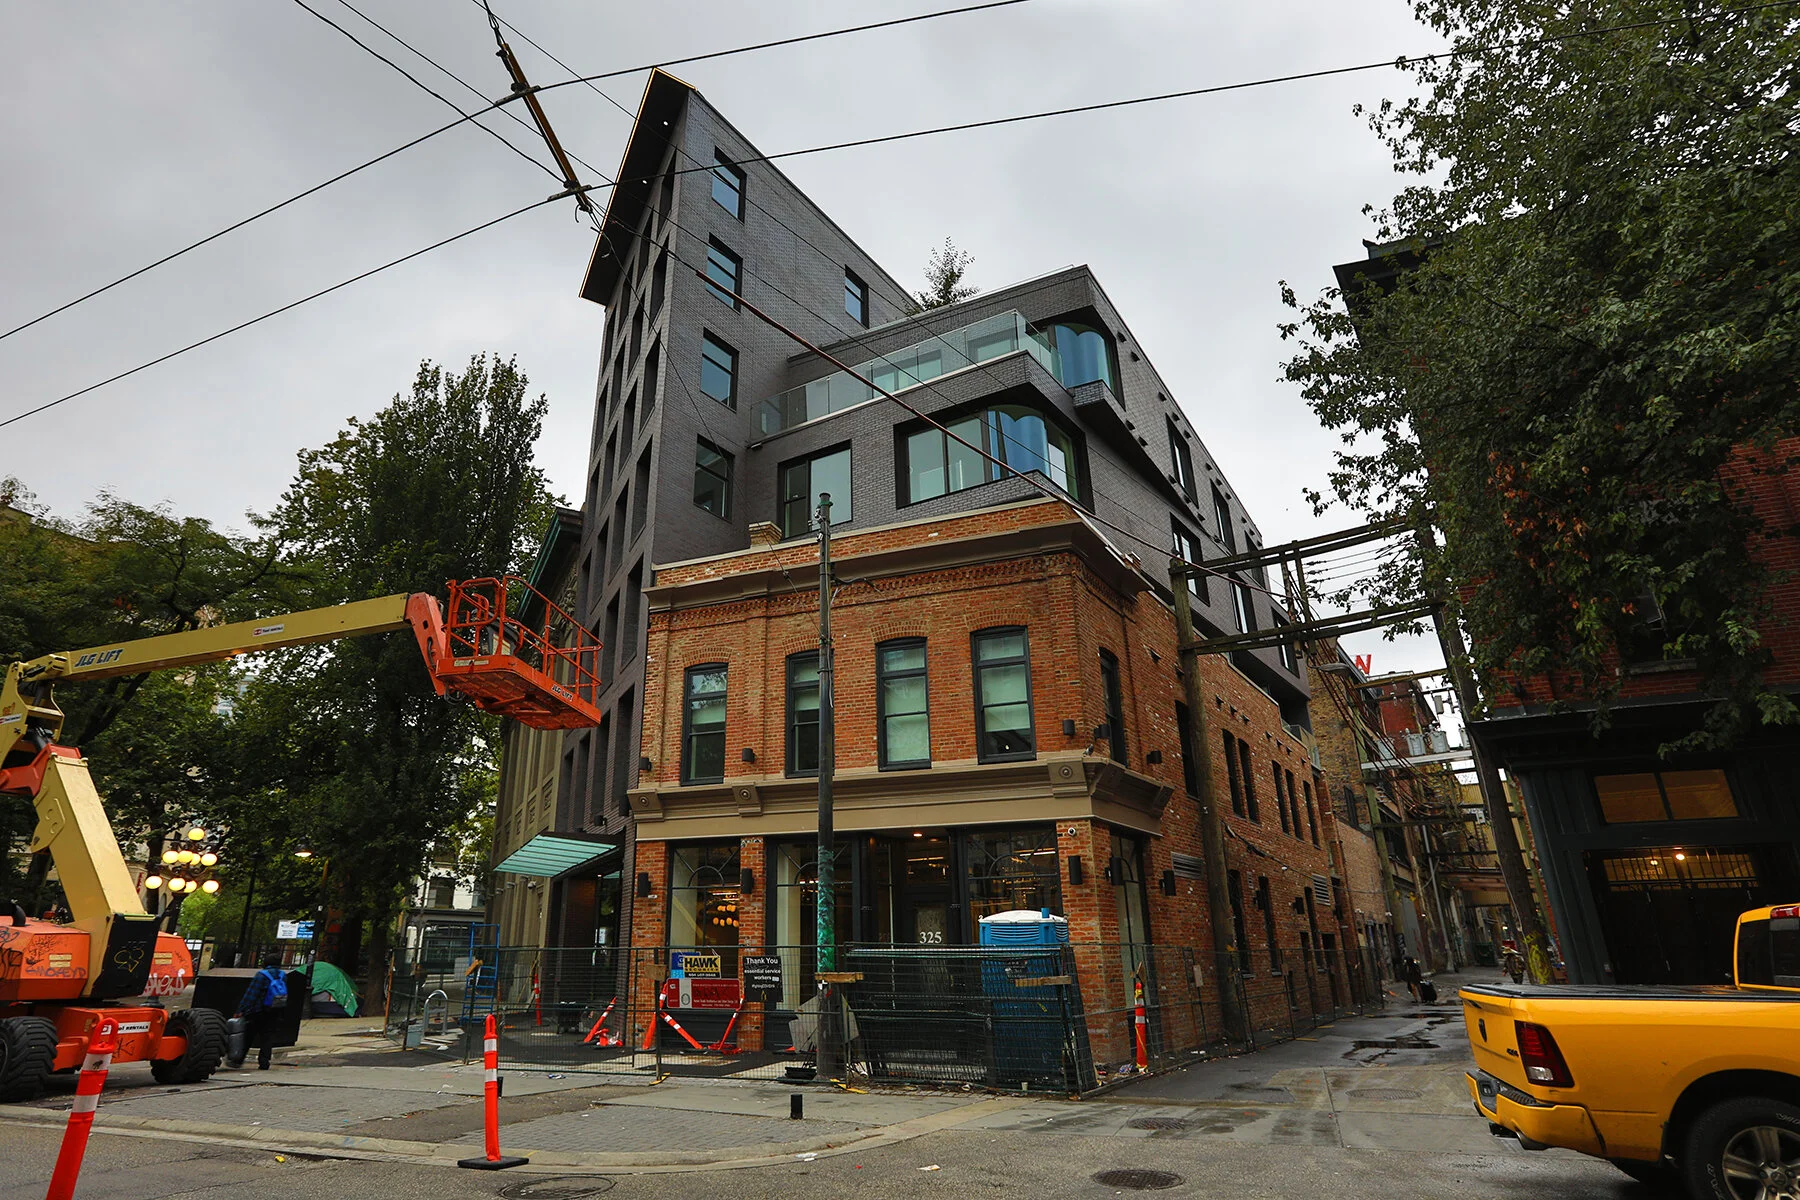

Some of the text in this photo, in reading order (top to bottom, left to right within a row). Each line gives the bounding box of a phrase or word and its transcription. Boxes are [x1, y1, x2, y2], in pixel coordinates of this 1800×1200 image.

[75, 648, 123, 668] JLG LIFT
[919, 931, 942, 944] 325
[684, 957, 719, 968] HAWK
